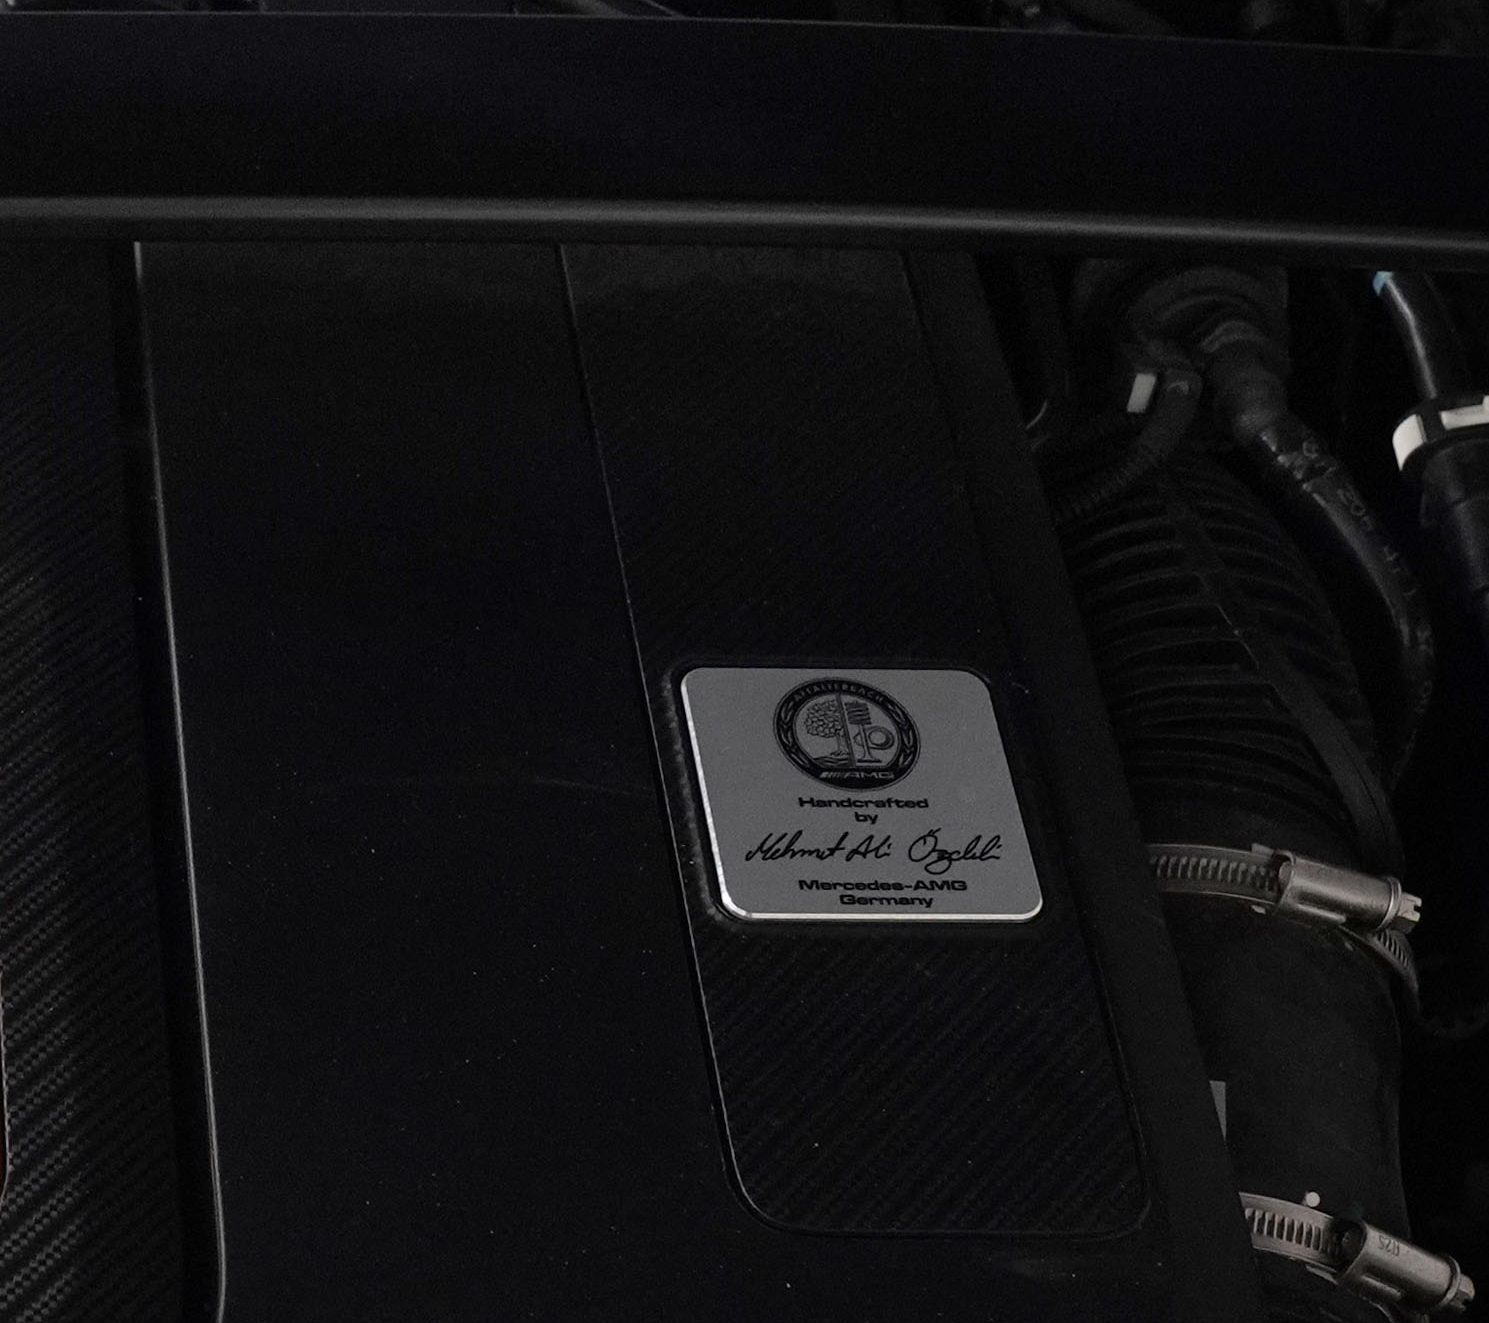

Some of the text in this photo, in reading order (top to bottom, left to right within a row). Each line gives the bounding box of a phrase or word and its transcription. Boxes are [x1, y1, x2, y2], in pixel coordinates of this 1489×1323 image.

[798, 797, 929, 809] Handcrafted
[854, 812, 878, 825] by
[846, 834, 892, 862] Ali
[798, 879, 967, 891] Mercedes-AMG
[839, 894, 933, 908] Germany
